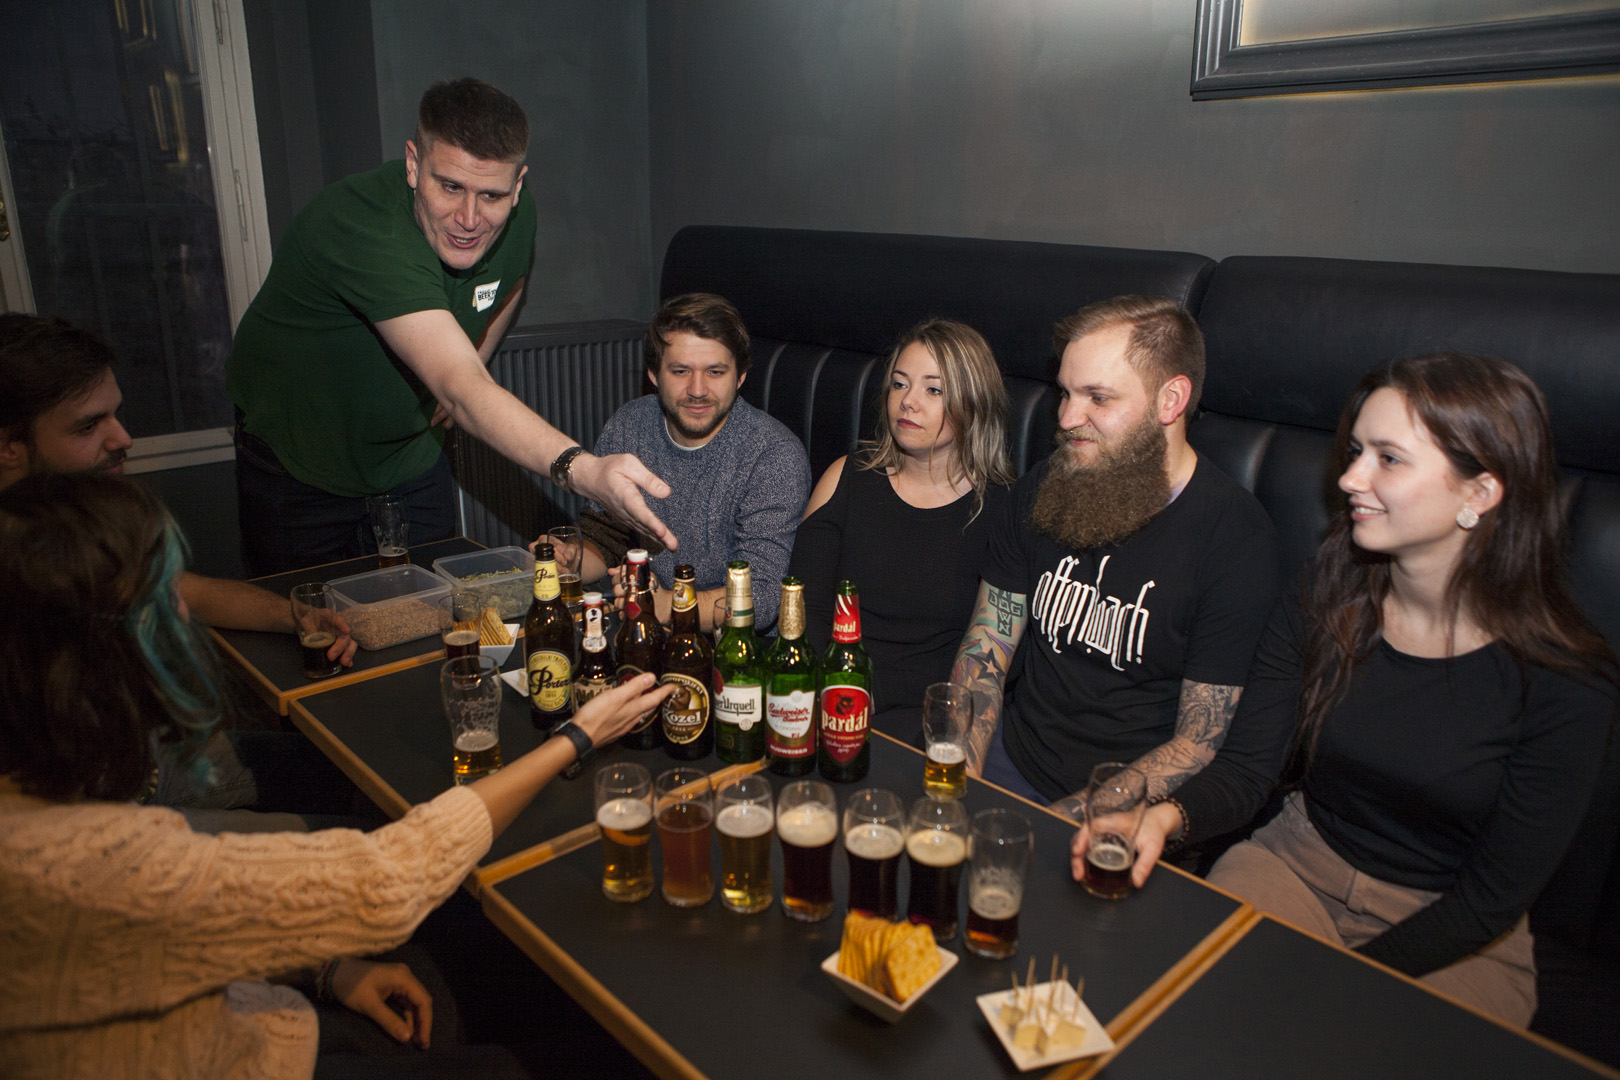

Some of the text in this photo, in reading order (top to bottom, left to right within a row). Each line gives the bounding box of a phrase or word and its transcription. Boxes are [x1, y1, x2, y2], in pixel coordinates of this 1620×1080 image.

[529, 665, 569, 695] Porter
[662, 707, 701, 725] Kozel
[768, 702, 810, 717] Budweiser
[770, 744, 808, 755] BUDWEISER
